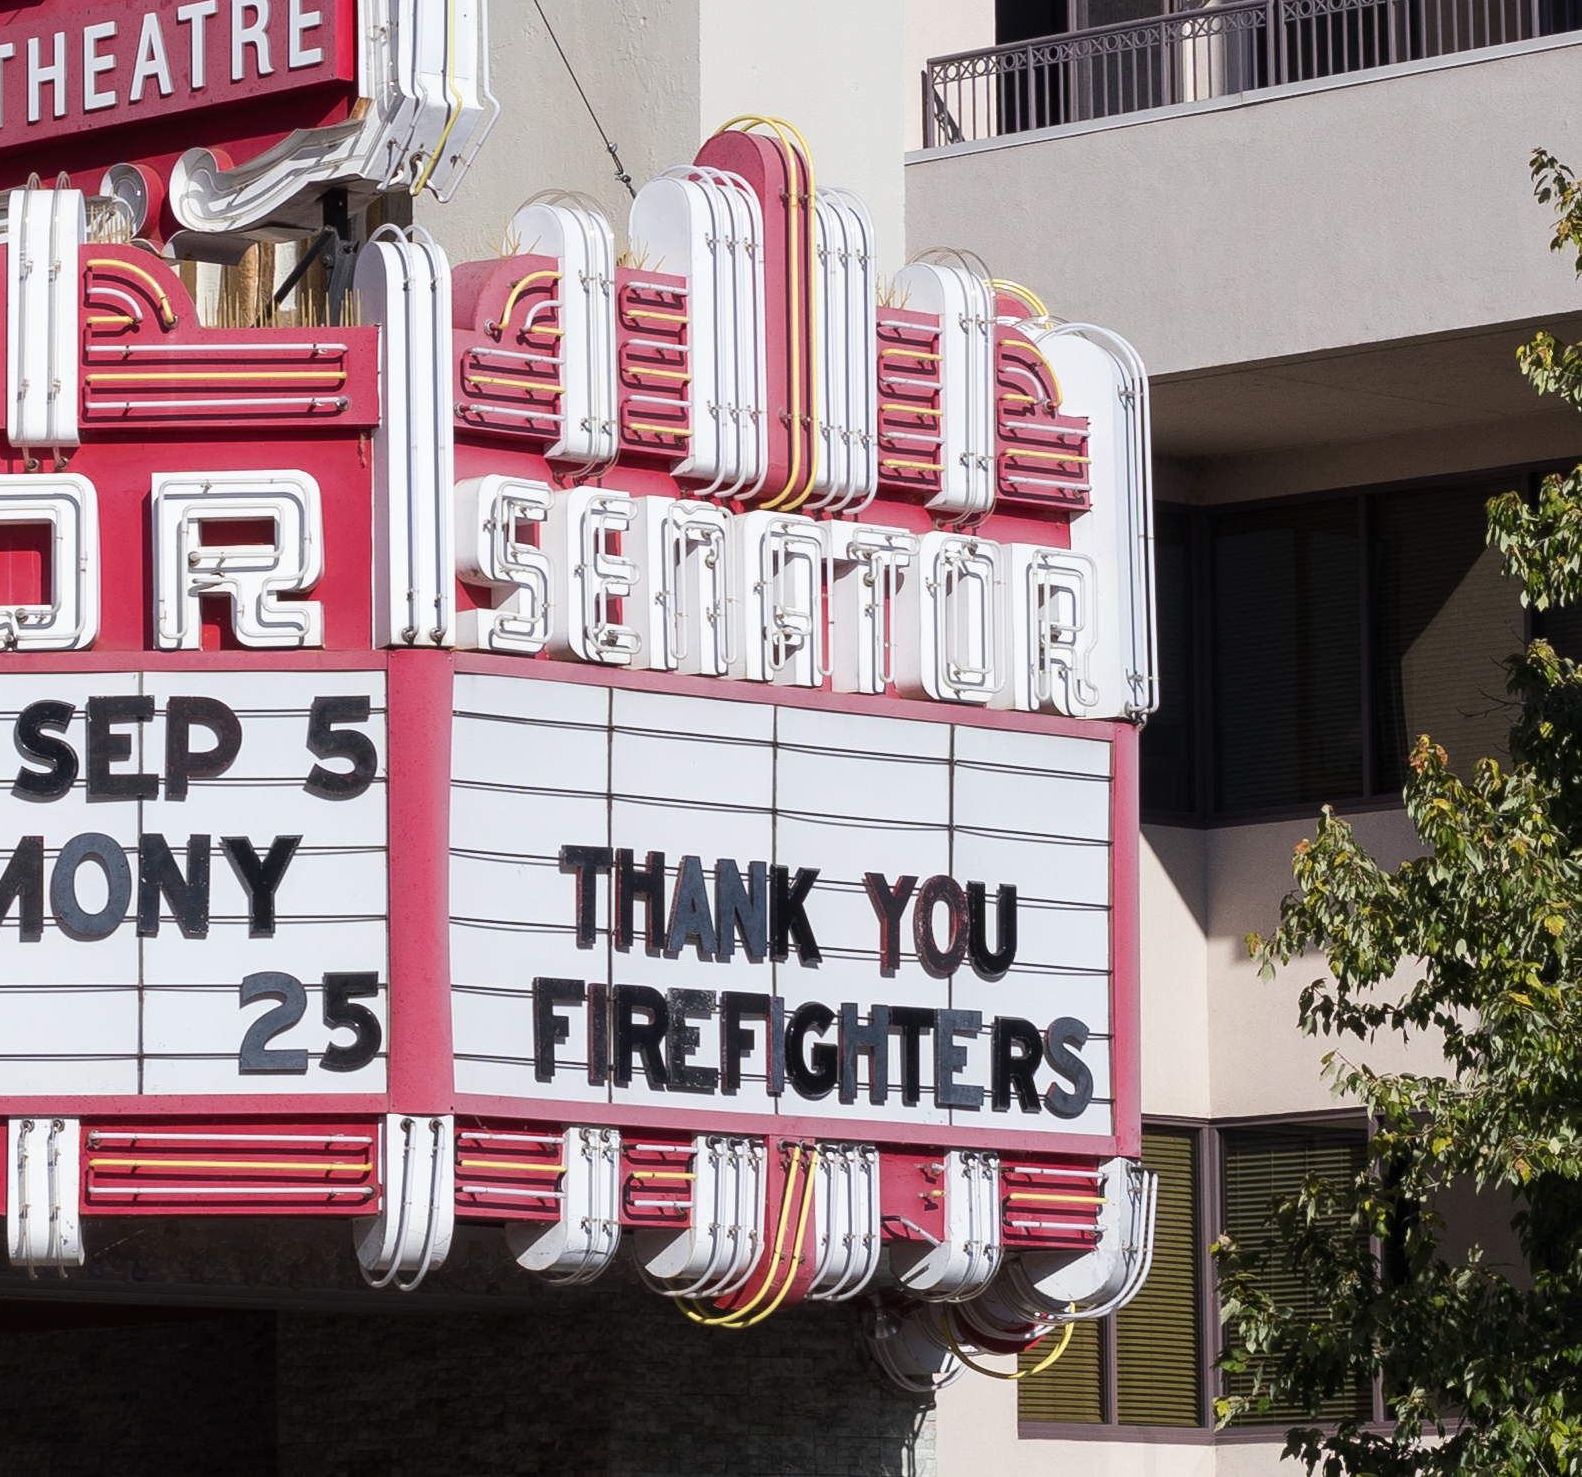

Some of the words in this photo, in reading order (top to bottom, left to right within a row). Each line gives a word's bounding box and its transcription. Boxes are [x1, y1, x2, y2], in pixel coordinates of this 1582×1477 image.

[454, 473, 1100, 720] SENATOR
[12, 695, 242, 803] SEP
[303, 695, 378, 800] 5
[558, 844, 822, 967] THANK
[864, 871, 1018, 981] YOU
[238, 970, 382, 1075] 25
[532, 977, 1094, 1118] FIREFIGHTERS
